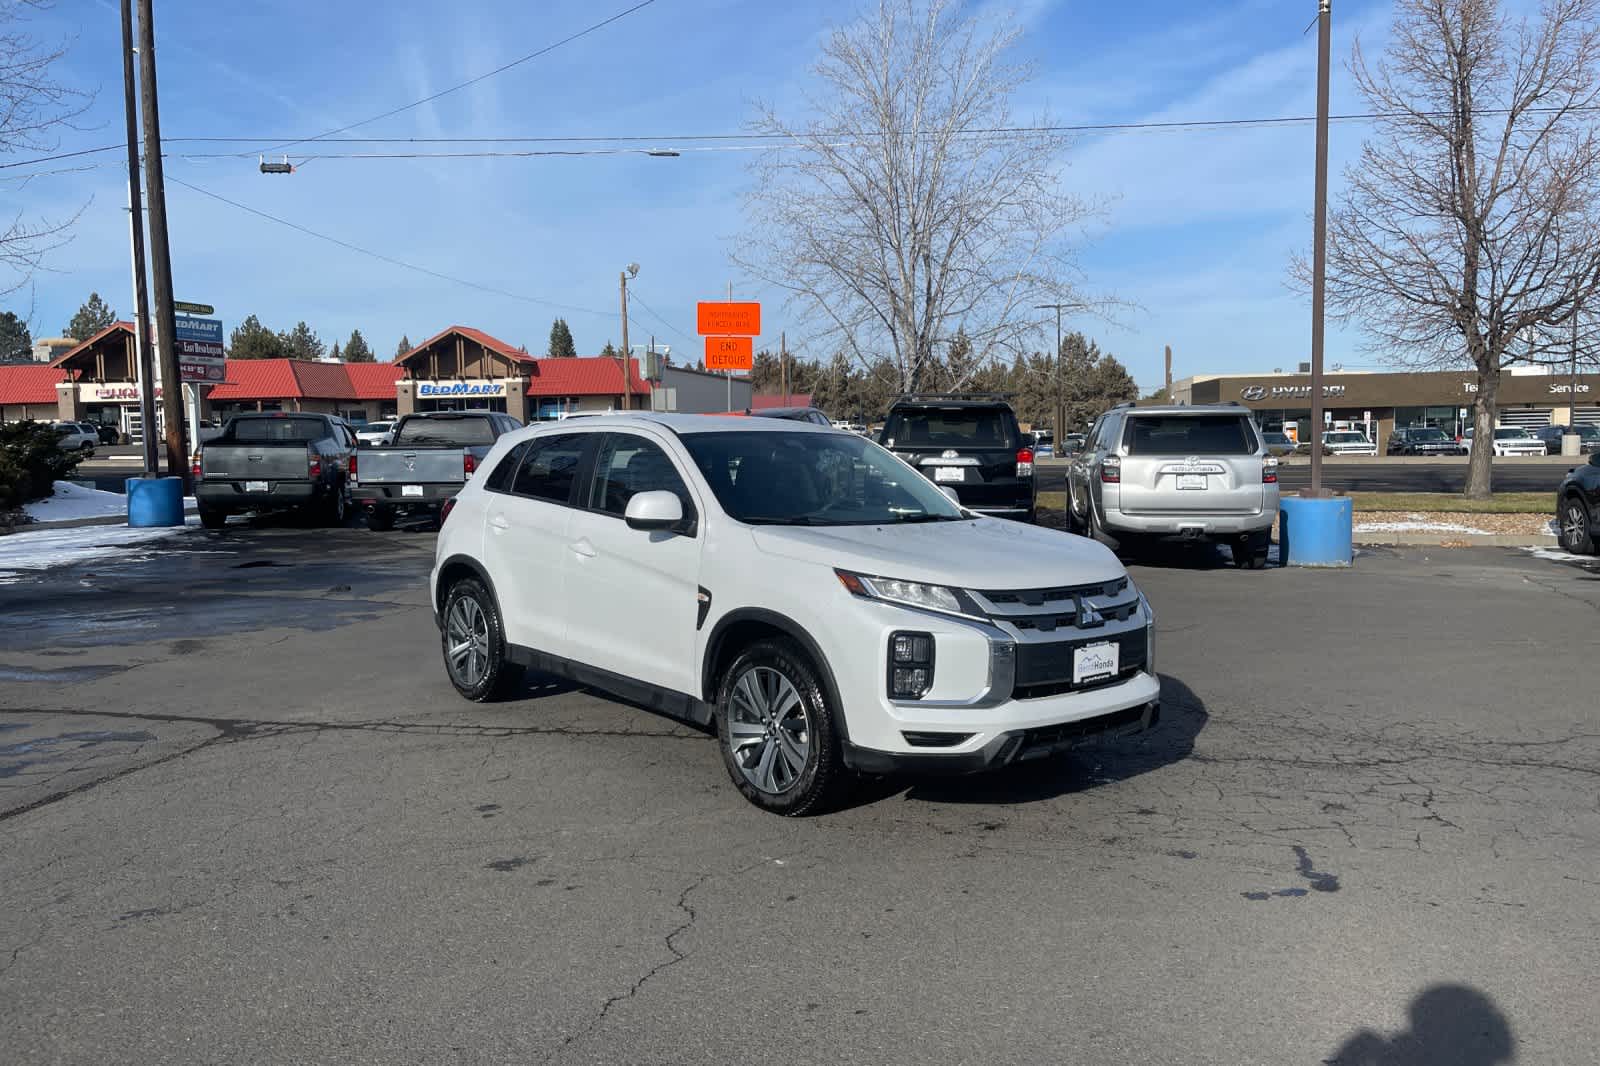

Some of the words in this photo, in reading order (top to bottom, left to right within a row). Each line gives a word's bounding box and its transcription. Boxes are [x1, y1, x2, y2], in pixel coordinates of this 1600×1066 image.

[176, 320, 218, 331] EDMART
[720, 342, 737, 351] END
[712, 354, 745, 365] DETOUR
